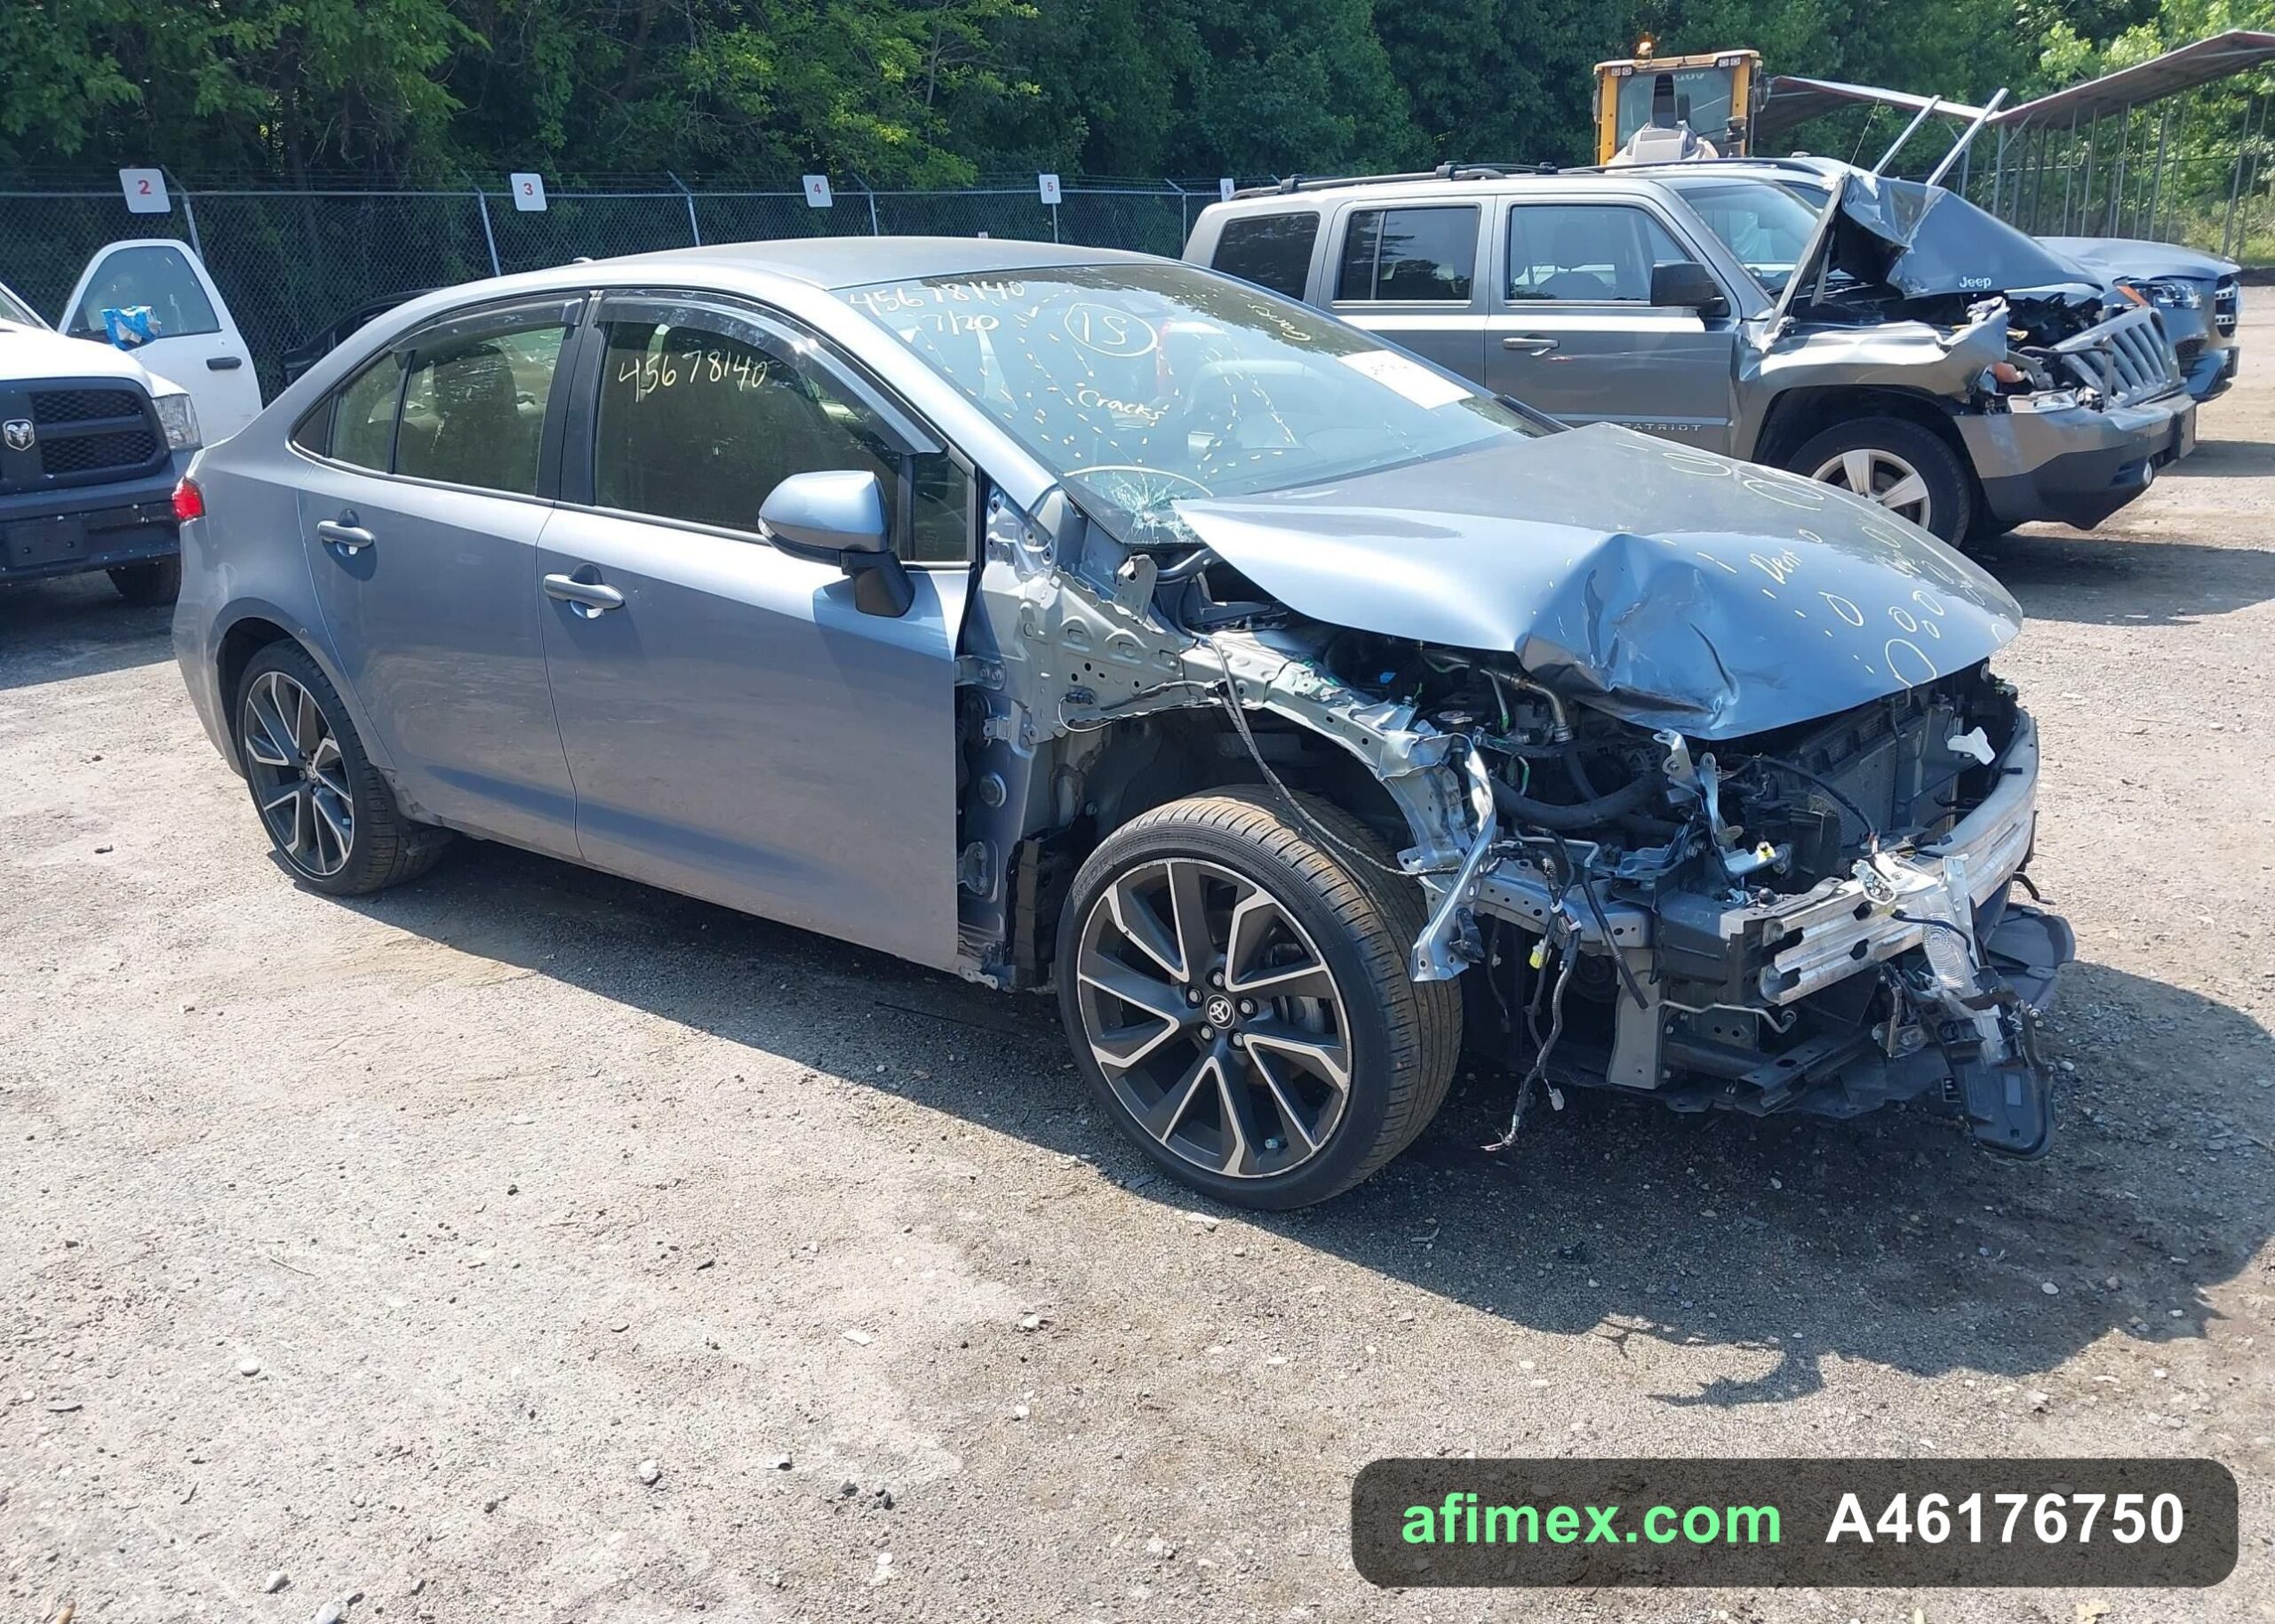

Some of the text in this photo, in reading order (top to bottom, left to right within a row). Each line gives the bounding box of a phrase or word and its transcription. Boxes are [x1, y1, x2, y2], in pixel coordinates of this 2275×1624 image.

[137, 179, 152, 195] 2
[523, 183, 533, 196] 3
[813, 183, 822, 195] 4
[1047, 181, 1054, 193] 5
[1959, 276, 1992, 290] Jeep
[921, 310, 1000, 335] 7/20
[1749, 547, 1803, 585] Dent
